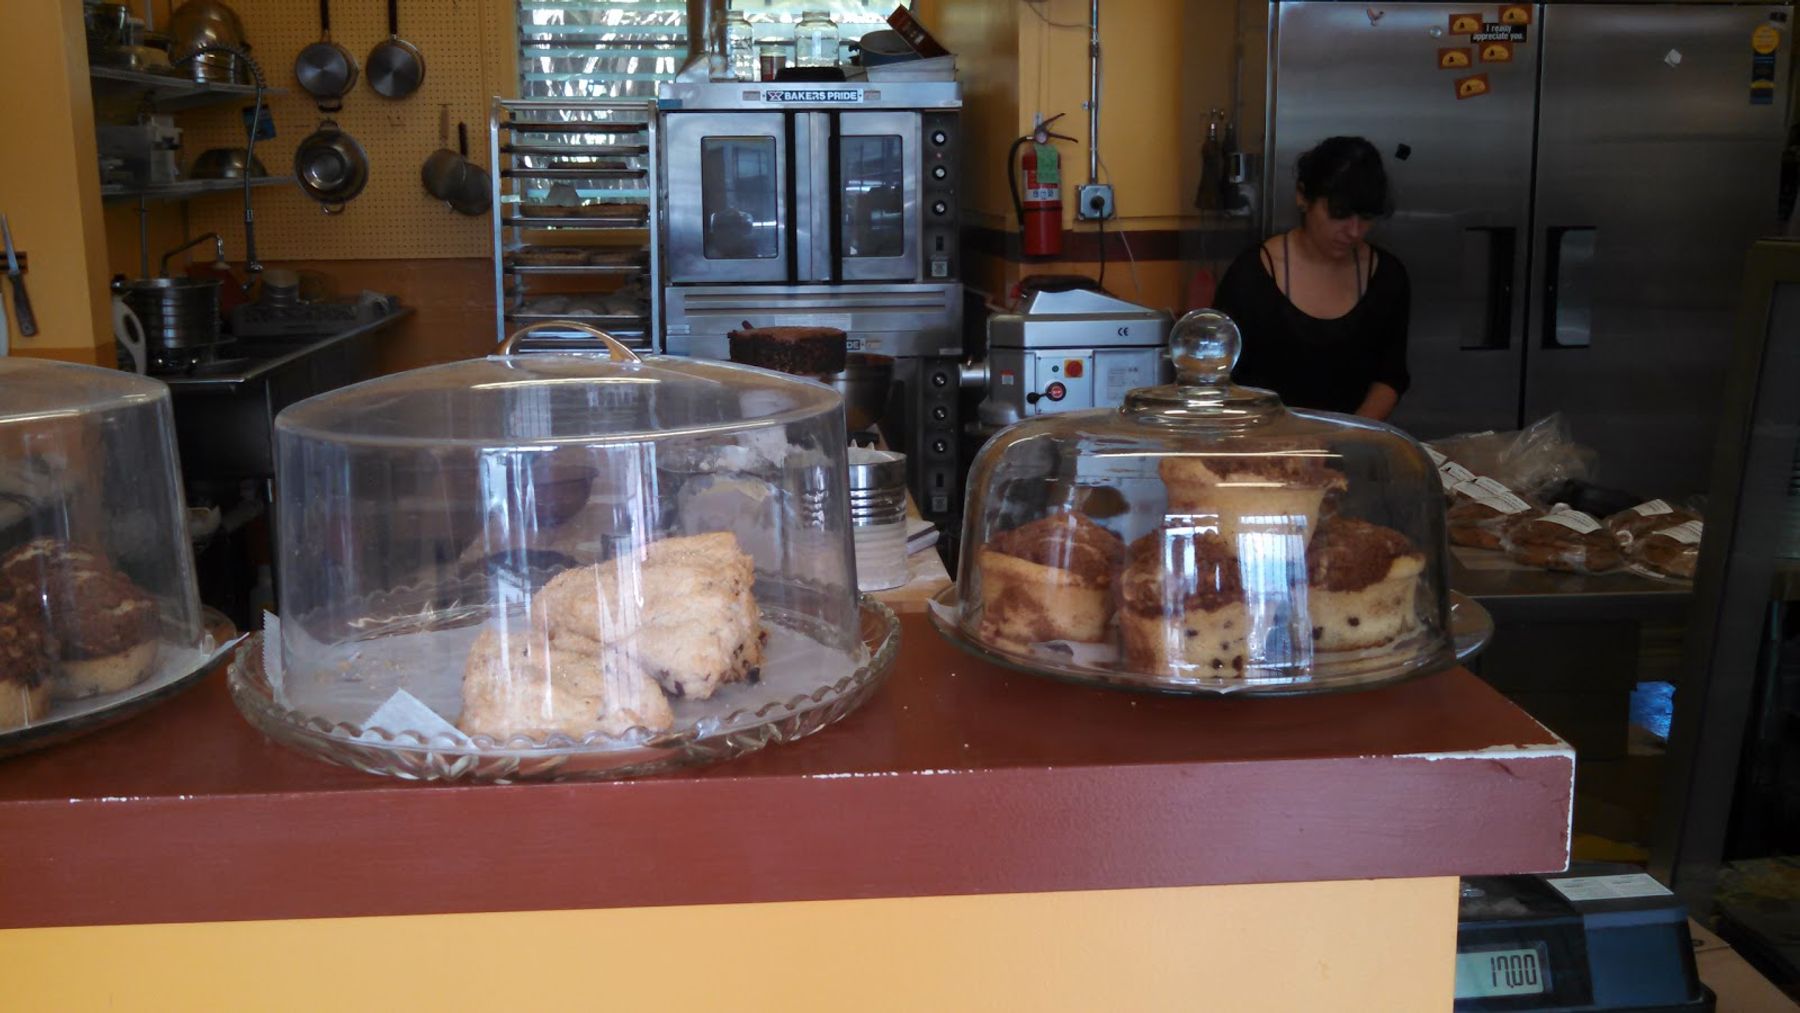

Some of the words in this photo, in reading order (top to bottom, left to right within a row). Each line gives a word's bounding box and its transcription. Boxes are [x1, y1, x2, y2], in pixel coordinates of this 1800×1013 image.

[1491, 24, 1511, 33] really
[1472, 32, 1508, 42] appreciate
[784, 91, 825, 101] BAKERS
[827, 91, 857, 101] PRIDE
[1117, 327, 1129, 336] CE
[1490, 954, 1537, 988] 17.00
